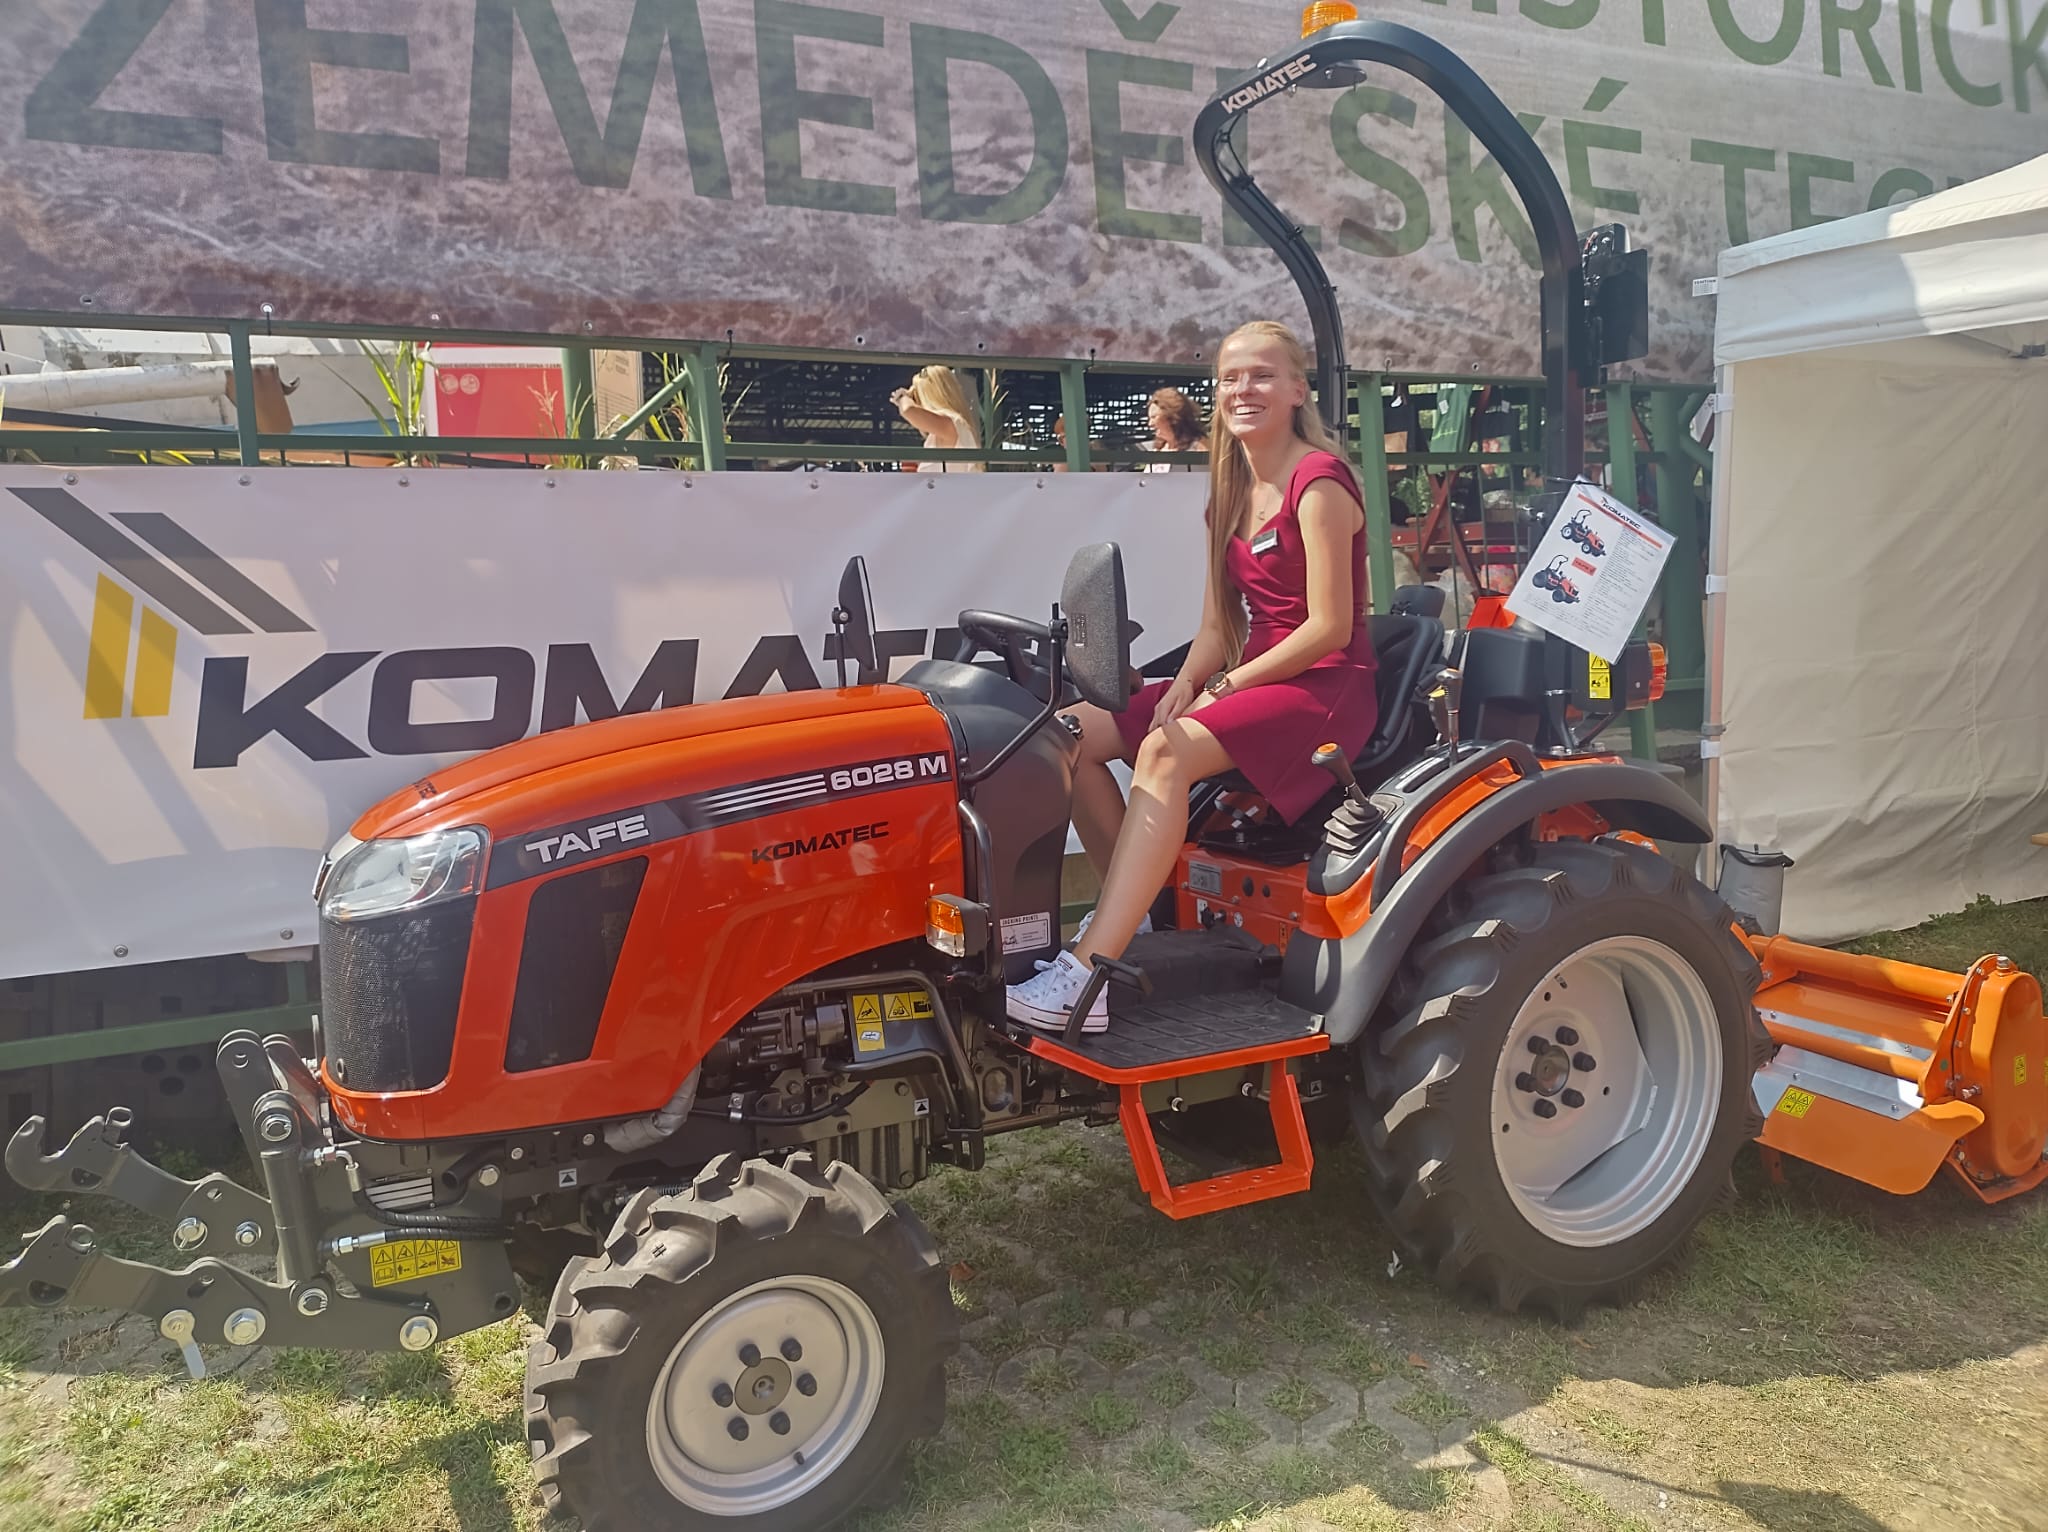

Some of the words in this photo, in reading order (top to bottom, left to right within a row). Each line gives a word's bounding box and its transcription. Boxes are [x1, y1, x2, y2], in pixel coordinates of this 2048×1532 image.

[1221, 53, 1318, 114] KOMATEC
[1690, 138, 1966, 248] TE
[829, 760, 915, 791] 6028
[918, 755, 948, 777] M
[525, 813, 650, 864] TAFE
[751, 820, 890, 865] KOMATEC
